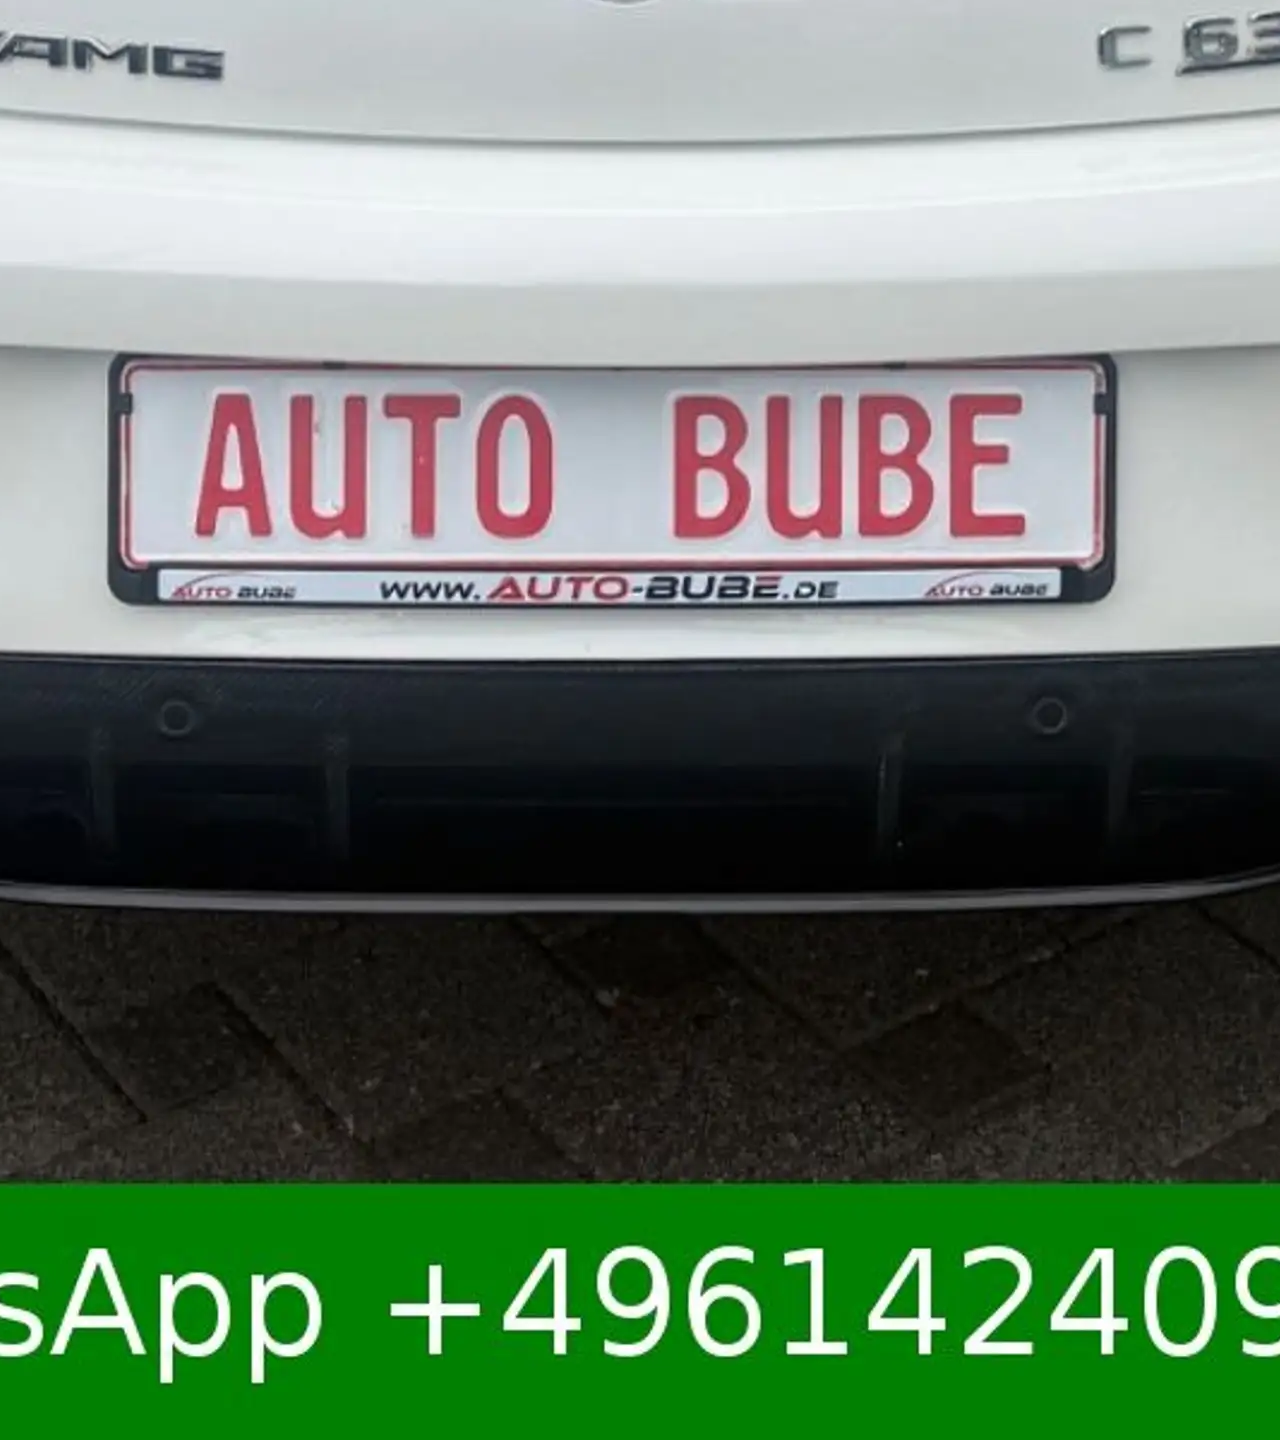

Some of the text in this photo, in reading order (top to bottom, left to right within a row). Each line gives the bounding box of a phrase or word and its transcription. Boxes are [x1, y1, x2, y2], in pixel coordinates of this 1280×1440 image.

[1096, 24, 1154, 72] C
[195, 394, 1026, 539] AUTO BUBE
[170, 584, 231, 600] AUTO
[378, 573, 841, 603] WWW.AUTO-BUBE.DE
[923, 584, 985, 599] AUTO
